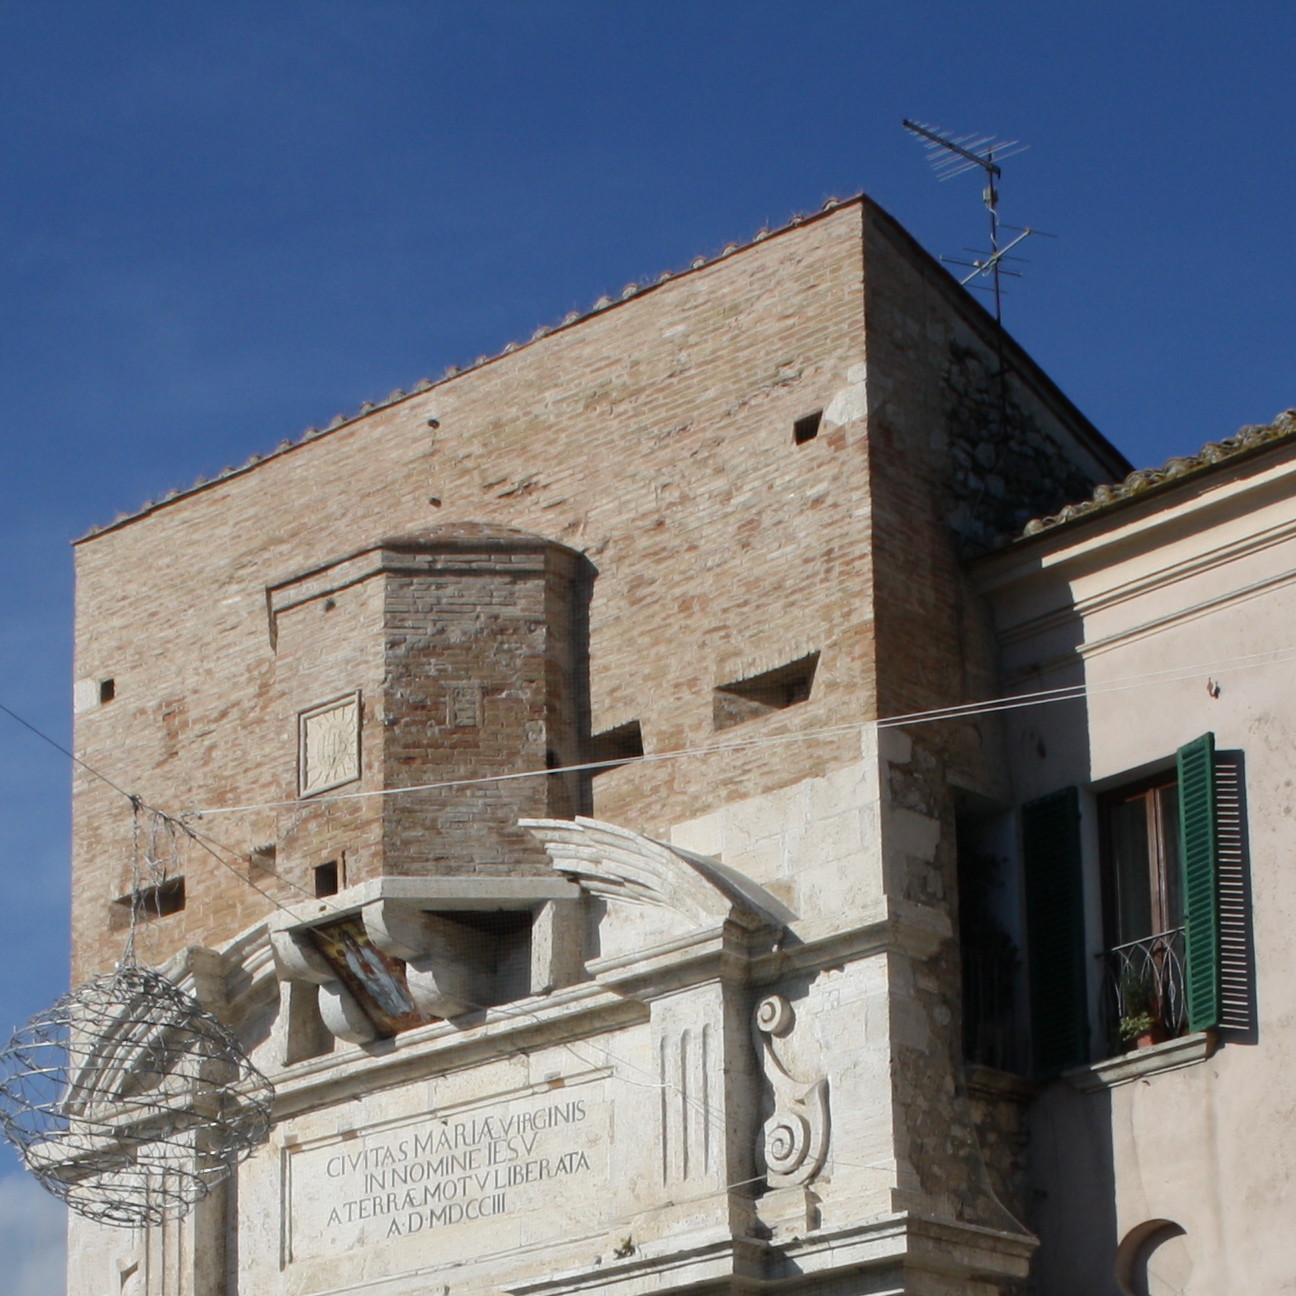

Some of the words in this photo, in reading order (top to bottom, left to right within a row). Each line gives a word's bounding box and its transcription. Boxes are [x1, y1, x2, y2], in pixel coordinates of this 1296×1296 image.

[326, 1139, 409, 1178] CIVITAS
[498, 1099, 587, 1137] VIRGINIS
[364, 1168, 386, 1194] IN
[391, 1149, 481, 1187] NOMINE
[487, 1132, 539, 1167] IESV
[326, 1206, 342, 1228] A
[494, 1150, 591, 1190] LIBERATA
